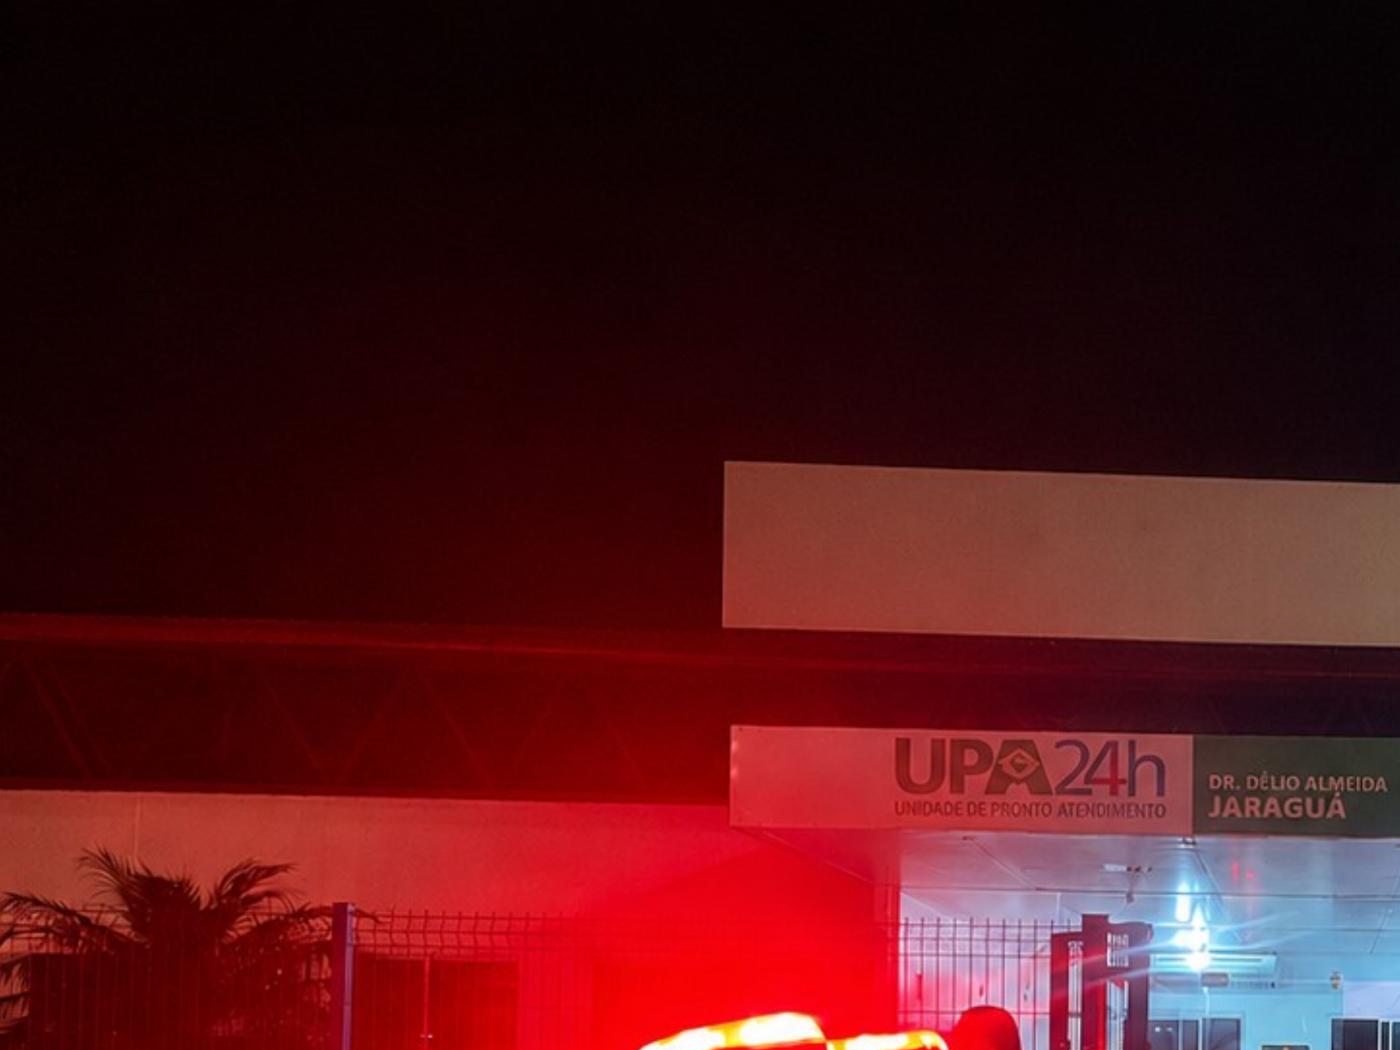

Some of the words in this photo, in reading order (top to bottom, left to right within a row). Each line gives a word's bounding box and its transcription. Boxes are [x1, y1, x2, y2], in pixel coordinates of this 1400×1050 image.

[1209, 774, 1240, 790] DR.
[1246, 771, 1300, 791] DÉLIO
[1304, 775, 1388, 793] ALMEIDA
[895, 800, 964, 817] UNIDADE
[967, 801, 987, 817] DE
[990, 801, 1052, 818] PRONTO
[1058, 802, 1166, 819] ATENDIMENTO
[1208, 792, 1346, 819] JARAGUÁ
